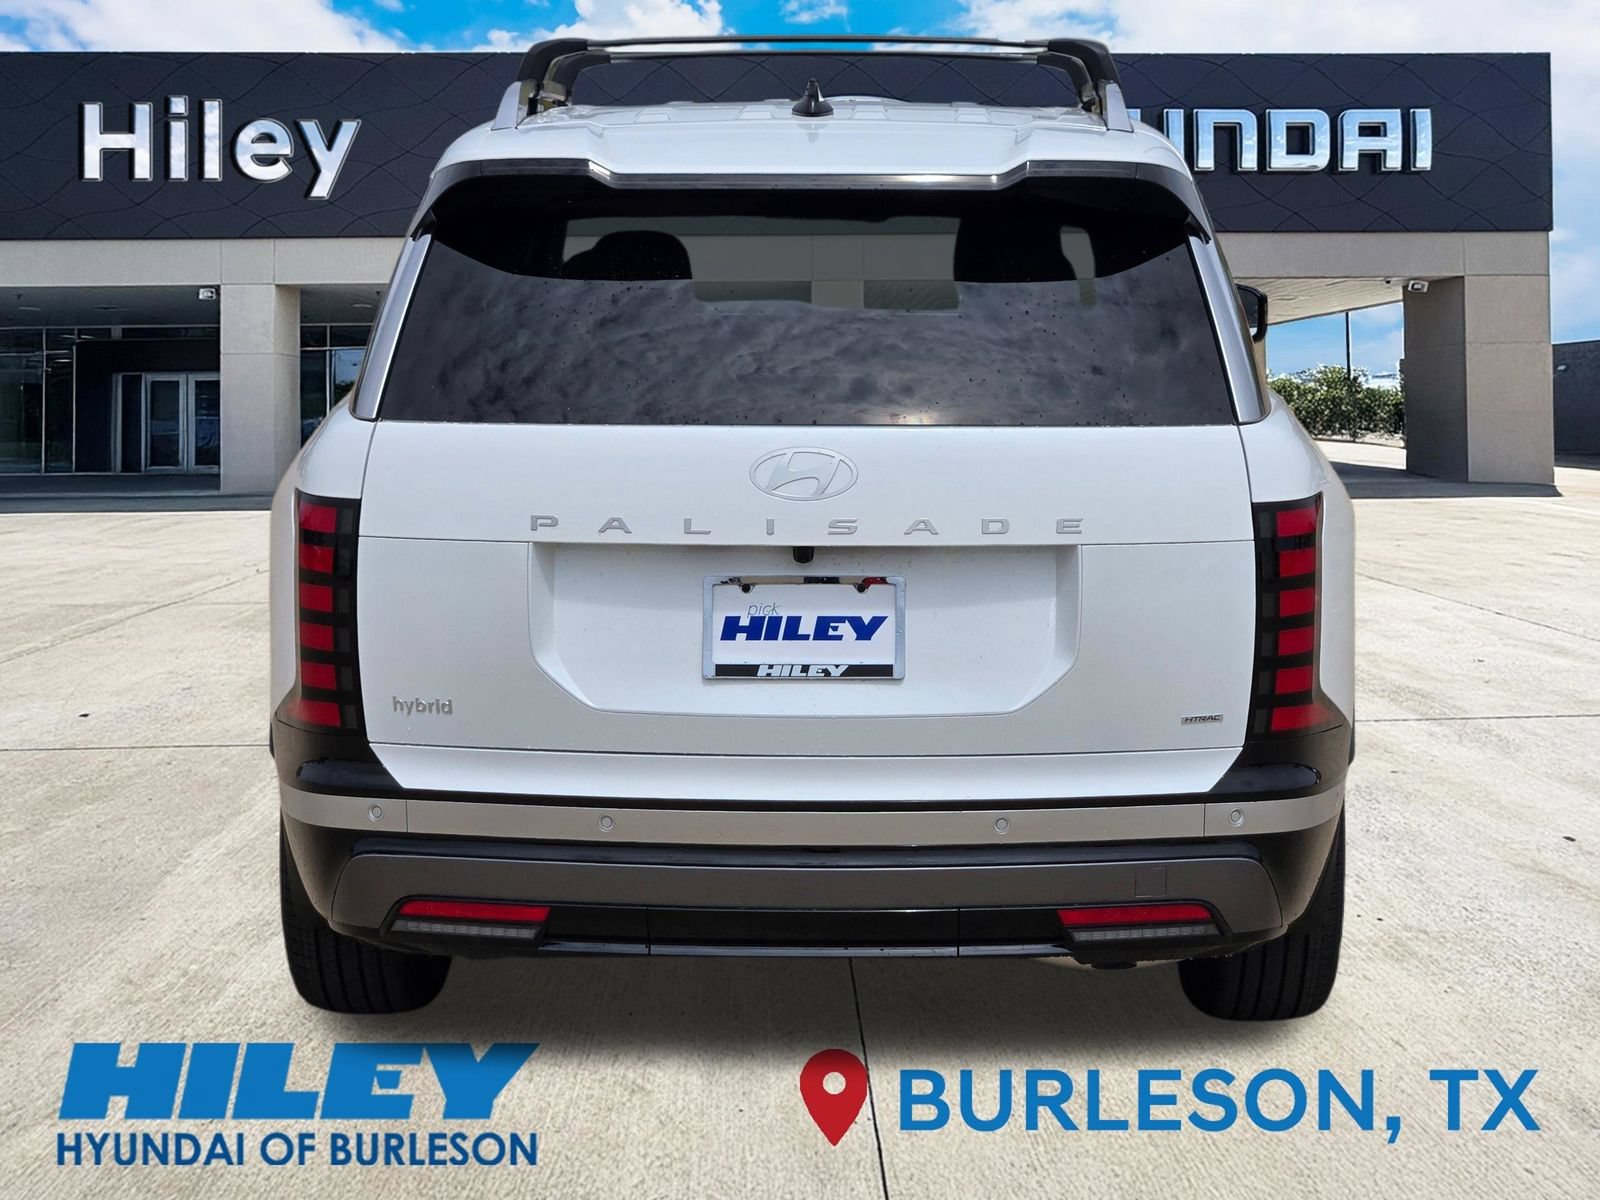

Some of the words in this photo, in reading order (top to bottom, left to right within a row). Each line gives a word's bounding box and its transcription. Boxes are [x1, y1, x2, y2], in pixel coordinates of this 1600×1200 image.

[80, 95, 362, 201] Hiley
[529, 514, 1085, 536] PALISADE
[747, 602, 781, 618] pick
[720, 615, 889, 641] HILEY
[756, 664, 850, 678] HILEY
[392, 696, 453, 716] hybrid
[1183, 714, 1222, 723] HTRAC
